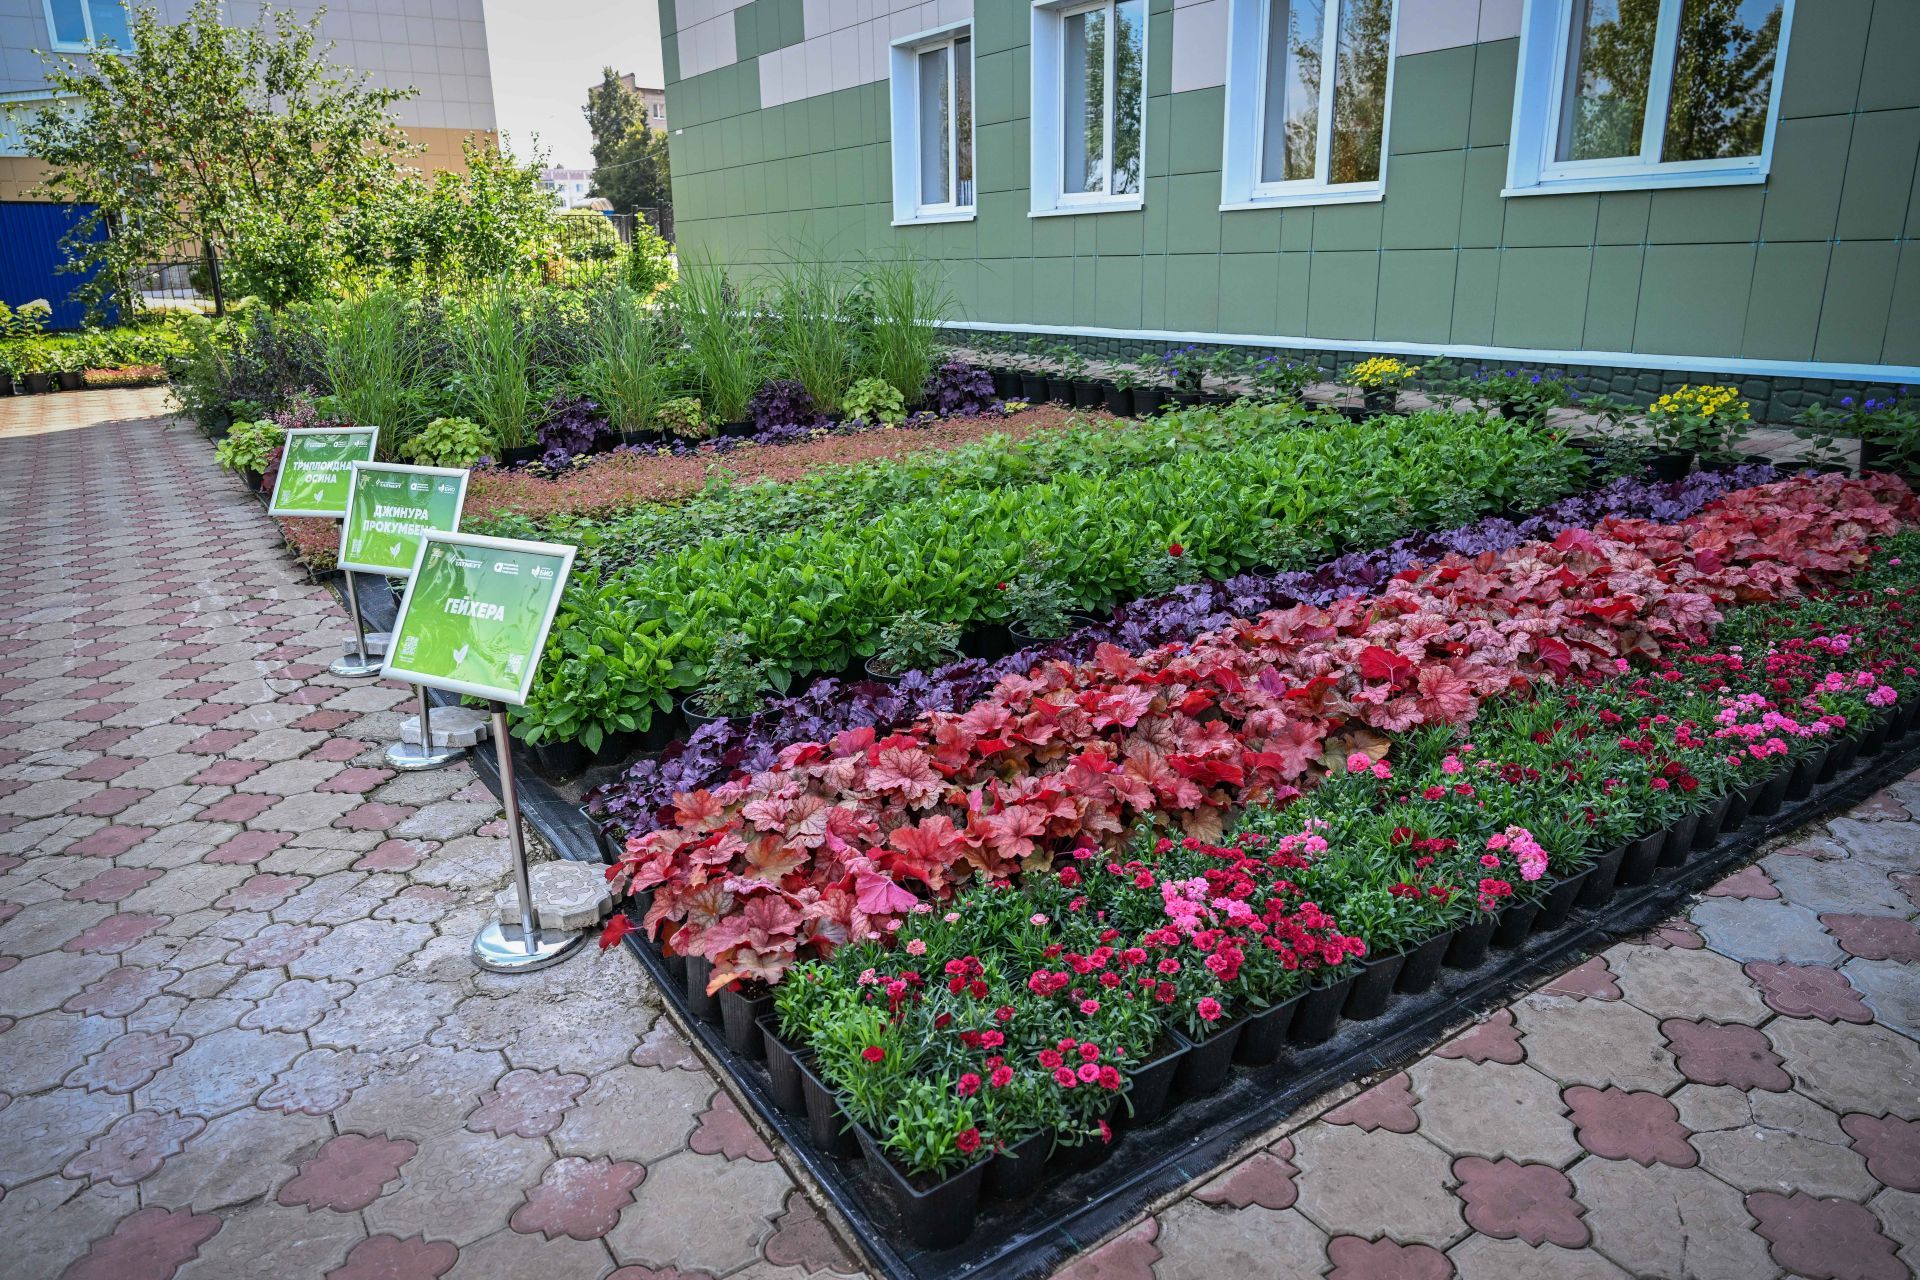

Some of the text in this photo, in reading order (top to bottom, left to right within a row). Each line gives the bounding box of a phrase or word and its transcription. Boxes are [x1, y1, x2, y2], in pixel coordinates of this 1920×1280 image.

[305, 474, 337, 484] ОСИНА
[374, 505, 429, 520] ДЖИНУРА
[444, 596, 504, 621] ГЕЙХЕРА
